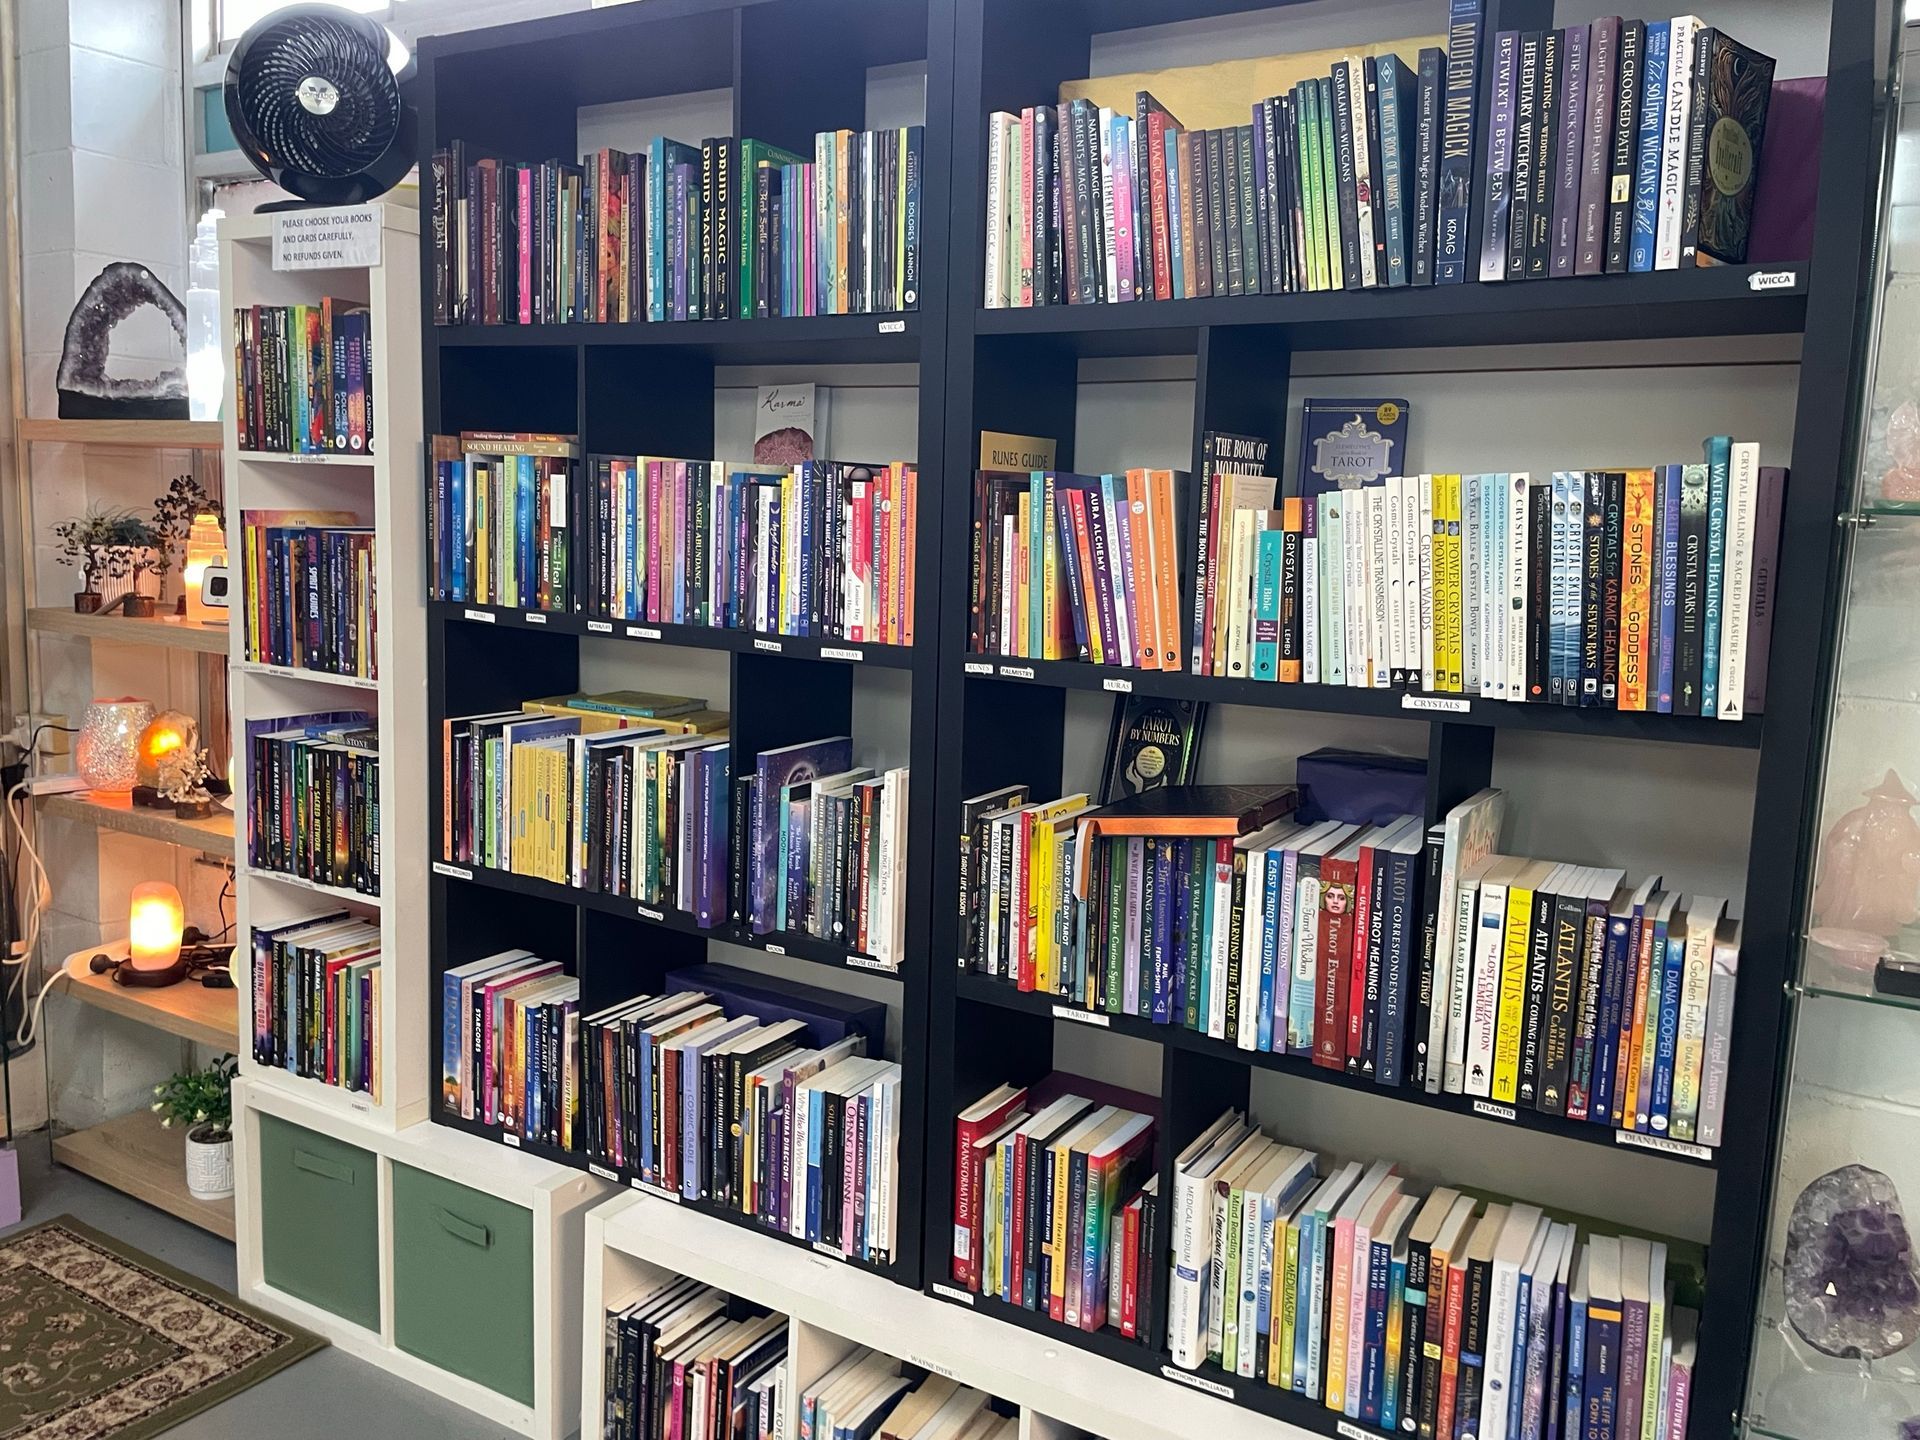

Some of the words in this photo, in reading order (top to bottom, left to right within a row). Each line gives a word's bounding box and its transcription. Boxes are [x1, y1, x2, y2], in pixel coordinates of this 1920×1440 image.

[1448, 22, 1476, 91] MODERN
[1624, 28, 1636, 58] THE
[1674, 26, 1685, 76] PRACTICAL
[1698, 36, 1708, 78] Greenaway
[1498, 38, 1512, 111] BETWIXT
[1520, 40, 1536, 118] HEREDITARY
[1620, 59, 1634, 128] CROOKED
[1265, 104, 1273, 145] SIMPLY
[1336, 68, 1346, 117] QABALAH
[1341, 132, 1351, 184] WICCANS
[1444, 96, 1472, 160] MAGICK
[1668, 81, 1684, 144] CANDLE
[1088, 118, 1098, 162] NATURAL
[1617, 130, 1630, 168] PATH
[702, 146, 711, 204] DRUID
[718, 144, 727, 203] DRUID
[1152, 140, 1162, 192] MAGICAL
[1267, 148, 1275, 190] WICCA
[1491, 128, 1506, 202] BETWEEN
[1514, 121, 1531, 202] WITCHCRAFT
[1666, 150, 1681, 196] MAGIC
[1091, 166, 1100, 199] MAGIC
[282, 220, 304, 228] PLEASE
[305, 216, 330, 226] CHOOSE
[332, 216, 349, 225] YOUR
[350, 214, 372, 224] BOOKS
[1154, 194, 1164, 234] SHIELD
[1614, 210, 1622, 244] KELDEN
[282, 235, 296, 244] AND
[297, 233, 317, 242] CARDS
[318, 232, 354, 242] CAREFULLY,
[282, 254, 292, 262] NO
[294, 252, 321, 261] REFUNDS
[322, 250, 344, 260] GIVEN.
[702, 208, 711, 266] MAGIC
[718, 207, 726, 265] MAGIC
[1445, 218, 1456, 255] KRAIG
[1758, 276, 1791, 286] WICCA
[880, 322, 904, 332] WICCA
[761, 388, 806, 412] Karma
[466, 443, 492, 452] SOUND
[492, 444, 525, 452] HEALING
[992, 450, 1018, 467] RUNES
[1022, 452, 1048, 470] GUIDE
[1215, 437, 1232, 457] THE
[1233, 440, 1254, 460] BOOK
[1256, 442, 1269, 462] OF
[1330, 456, 1375, 468] TAROT
[1712, 463, 1726, 506] WATER
[1740, 450, 1750, 504] CRYSTAL
[1075, 503, 1085, 537] AURAS
[1089, 492, 1098, 520] AURA
[1736, 505, 1748, 547] HEALING
[1093, 522, 1106, 572] ALCHEMY
[1552, 522, 1566, 571] CRYSTAL
[1569, 522, 1582, 571] CRYSTAL
[1607, 503, 1618, 562] CRYSTALS
[1710, 508, 1724, 560] CRYSTAL
[552, 560, 562, 588] Heal
[1284, 533, 1296, 595] CRYSTALS
[1589, 535, 1600, 580] STONES
[1630, 522, 1642, 586] STONES
[1552, 576, 1565, 616] SKULLS
[1568, 576, 1580, 618] SKULLS
[1706, 562, 1722, 618] HEALING
[1733, 558, 1744, 602] SACRED
[1587, 604, 1598, 638] SEVEN
[1605, 578, 1618, 626] KARMIC
[756, 641, 766, 650] KYLE
[767, 642, 780, 651] GRAY
[824, 650, 844, 658] LOUISE
[846, 650, 858, 659] HAY
[1283, 628, 1291, 657] LEMBO
[1586, 640, 1597, 670] RAYS
[1602, 627, 1616, 682] HEALING
[1626, 610, 1641, 684] GODDESS
[968, 664, 990, 674] RUNES
[1001, 668, 1032, 678] PALMISTRY
[1106, 680, 1130, 691] AURAS
[1414, 698, 1460, 710] CRYSTALS
[346, 738, 369, 750] STONE
[1130, 728, 1142, 740] BY
[1142, 731, 1180, 746] NUMBERS
[1142, 715, 1174, 734] TAROT
[1001, 828, 1010, 874] PSYCHIC
[1114, 883, 1122, 905] Tarot
[1268, 860, 1278, 888] EASY
[1394, 860, 1408, 902] TAROT
[1000, 878, 1009, 914] TAROT
[1266, 891, 1276, 926] TAROT
[1357, 896, 1366, 936] ULTIMATE
[1558, 902, 1582, 913] Collins
[1230, 906, 1244, 960] LEARNING
[1328, 917, 1342, 956] TAROT
[1370, 910, 1382, 944] TAROT
[1458, 893, 1470, 951] LEMURIA
[767, 946, 783, 954] MOON
[848, 957, 866, 966] HOUSE
[1262, 927, 1274, 976] READING
[1386, 904, 1404, 1016] CORRESPONDENCES
[1504, 916, 1527, 1003] ATLANTIS
[1530, 928, 1549, 993] ATLANTIS
[1693, 935, 1708, 957] The
[1108, 968, 1118, 996] Spirit
[1228, 962, 1238, 983] THE
[1367, 946, 1380, 1001] MEANINGS
[1552, 920, 1576, 1014] ATLANTIS
[1690, 958, 1705, 1000] Golden
[1227, 984, 1240, 1019] TAROT
[1324, 958, 1340, 1027] EXPERIENCE
[1452, 964, 1464, 1020] ATLANTIS
[1474, 976, 1487, 1024] LEMURIA
[1665, 969, 1679, 1007] DIANA
[1066, 1010, 1090, 1020] TAROT
[1660, 1008, 1674, 1059] COOPER
[1684, 1000, 1700, 1042] Future
[1546, 1014, 1560, 1071] CARIBBEAN
[1476, 1101, 1514, 1118] ATLANTIS
[1567, 1107, 1588, 1118] AUP
[1625, 1132, 1659, 1149] DIANA
[1660, 1140, 1703, 1157] COOPER
[960, 1136, 970, 1220] TRANSFORMATION
[1186, 1184, 1194, 1224] MEDICAL
[1232, 1194, 1240, 1218] Mind
[1250, 1198, 1258, 1221] MIND
[1184, 1225, 1192, 1264] MEDIUM
[1228, 1219, 1238, 1260] Reading
[1113, 1242, 1121, 1304] NUMEROLOGY
[1246, 1245, 1255, 1288] MEDICINE
[1338, 1263, 1348, 1290] THE
[1410, 1251, 1418, 1285] BRADEN
[1418, 1255, 1426, 1284] GREGG
[1431, 1256, 1444, 1292] DEEP
[936, 1286, 951, 1296] PAST
[952, 1289, 972, 1302] LIVES
[1284, 1261, 1296, 1328] MEDIUMSHIP
[1448, 1284, 1459, 1326] wisdom
[1335, 1300, 1346, 1332] MIND
[1332, 1338, 1344, 1381] MEDIC
[1446, 1328, 1456, 1354] codes
[910, 1354, 936, 1370] WAYNE
[936, 1365, 953, 1377] DYER
[1166, 1368, 1197, 1385] ANTHONY
[1198, 1378, 1232, 1397] WILLIAMS
[1340, 1426, 1363, 1439] GREG
